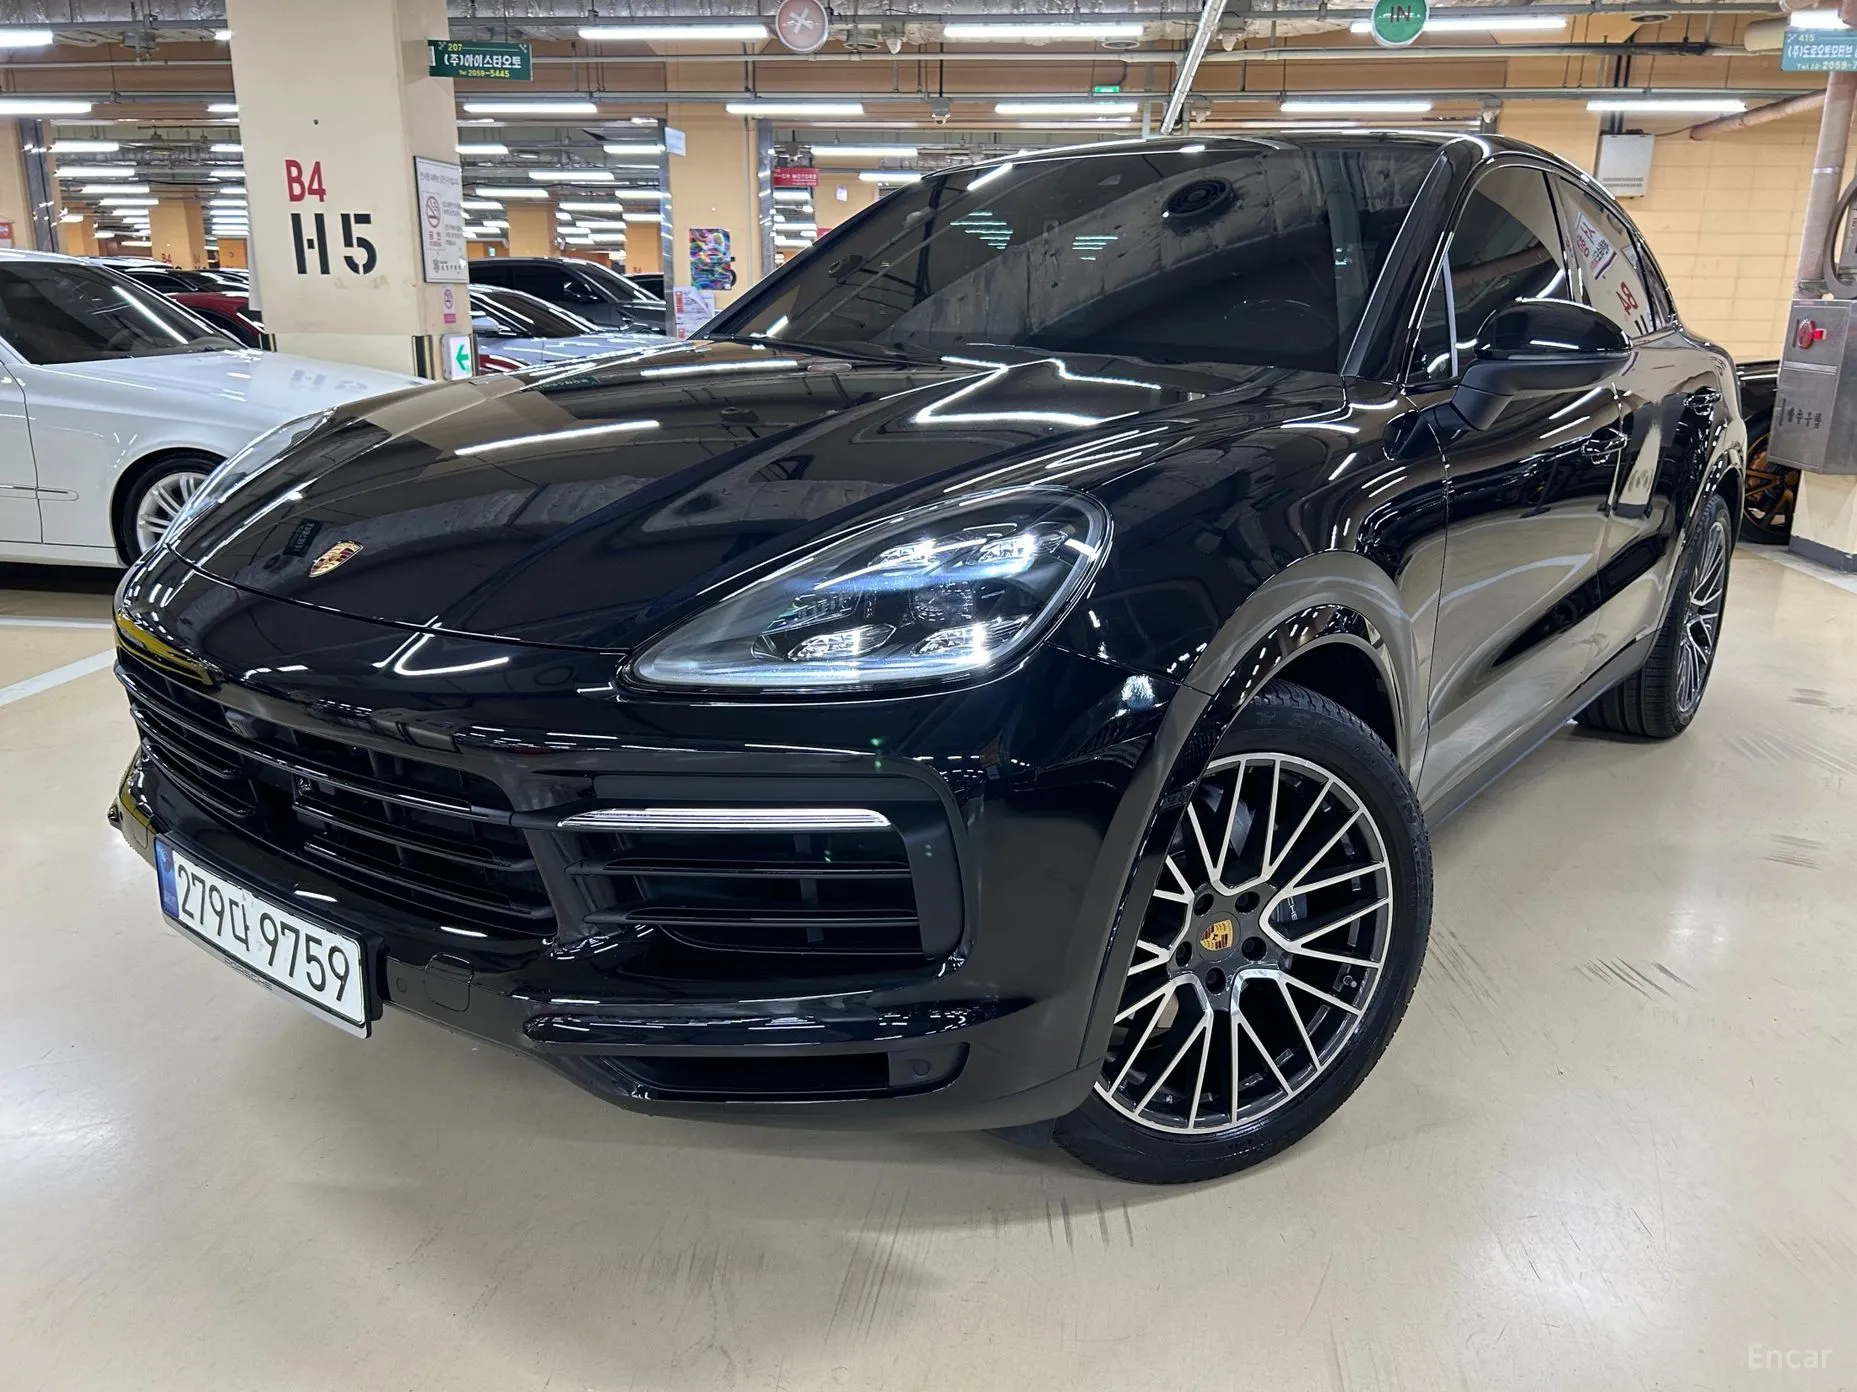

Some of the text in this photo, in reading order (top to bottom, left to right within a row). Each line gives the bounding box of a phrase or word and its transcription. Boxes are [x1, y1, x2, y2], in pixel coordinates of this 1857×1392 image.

[1390, 4, 1411, 23] IN
[447, 43, 463, 51] 207
[468, 69, 510, 77] 2059-5445
[285, 159, 327, 202] B4
[177, 863, 351, 1003] 279다 9759
